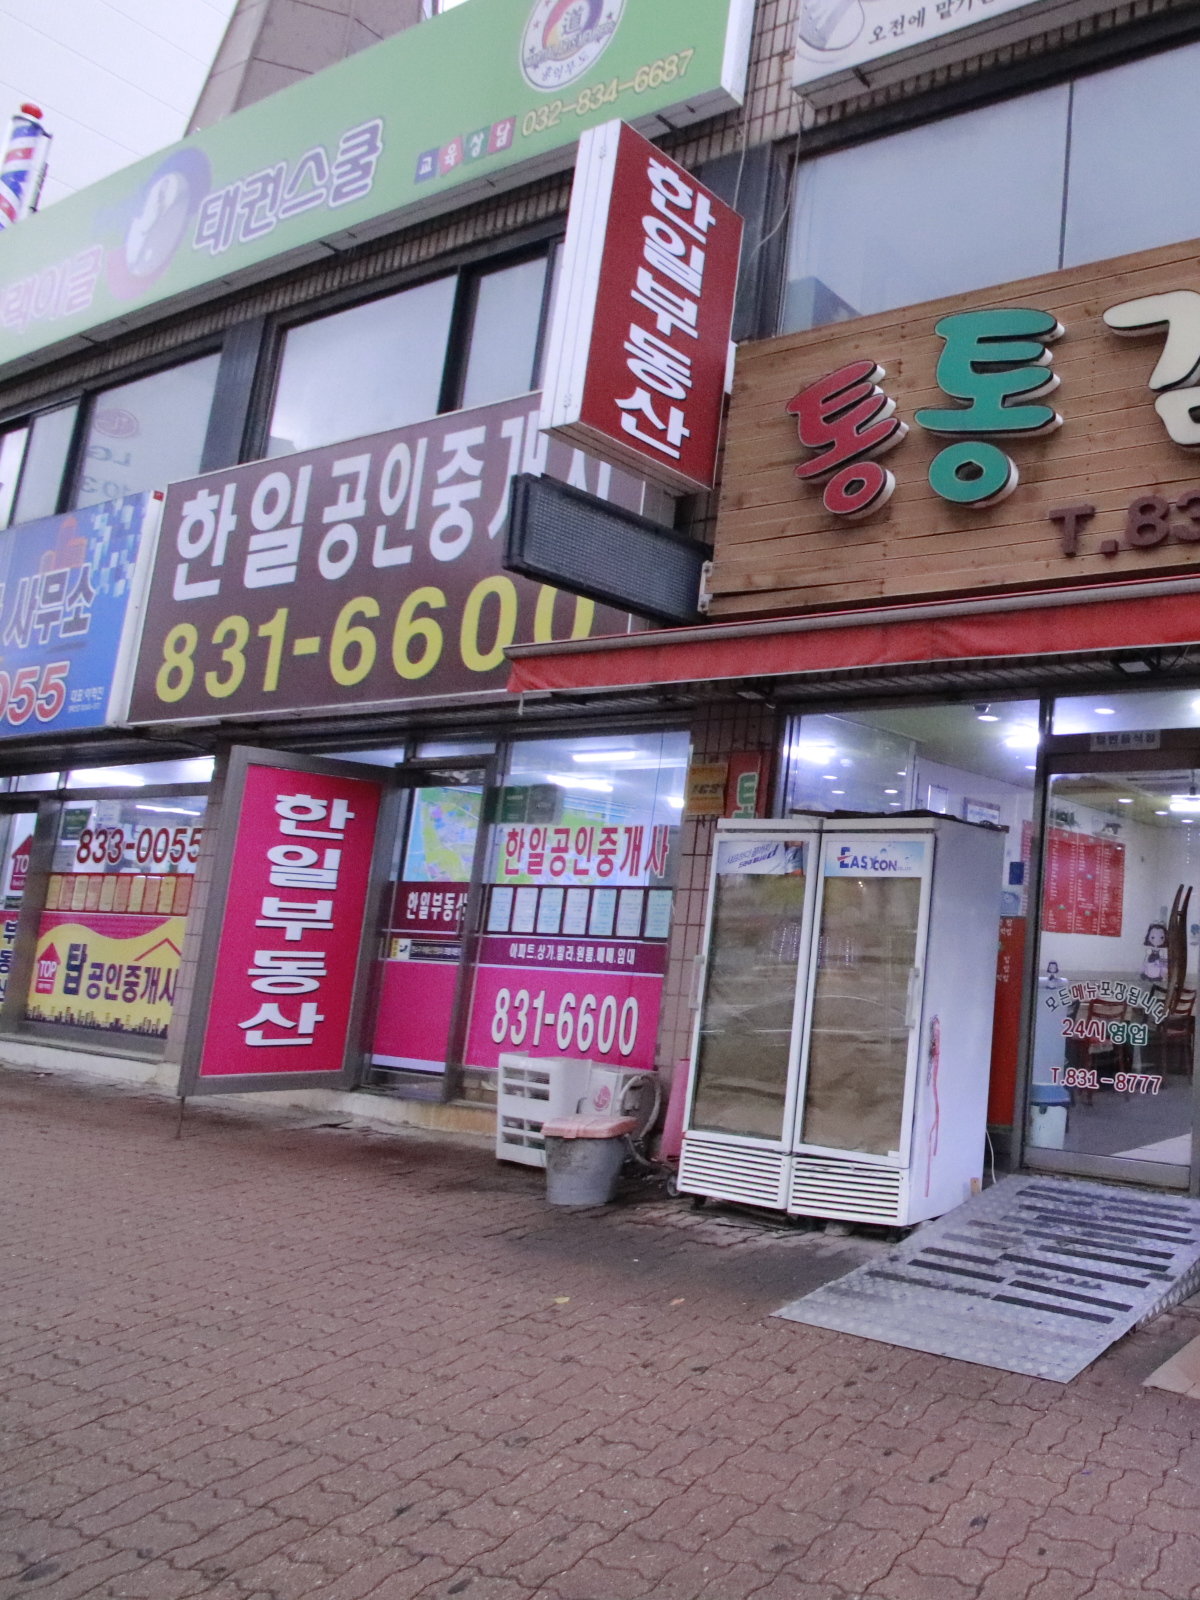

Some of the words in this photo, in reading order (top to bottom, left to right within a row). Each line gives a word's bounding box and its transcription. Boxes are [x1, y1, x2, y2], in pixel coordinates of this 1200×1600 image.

[868, 7, 926, 45] 오전에
[936, 0, 994, 20] 맡기
[419, 121, 511, 176] 교육상담
[521, 46, 696, 137] 032-834-6687
[192, 118, 384, 255] 태권스쿨
[614, 156, 720, 460] 한일부동산
[3, 562, 97, 649] 사무소
[156, 575, 595, 703] 831-6600
[15, 855, 28, 873] TO
[76, 827, 204, 865] 833-0055
[504, 825, 670, 878] 한일공인중개사
[238, 792, 355, 1048] 한일부동산
[39, 959, 57, 978] TOP
[63, 943, 88, 996] 탑
[491, 988, 639, 1056] 831-6600
[1050, 1067, 1163, 1095] T.831-8777
